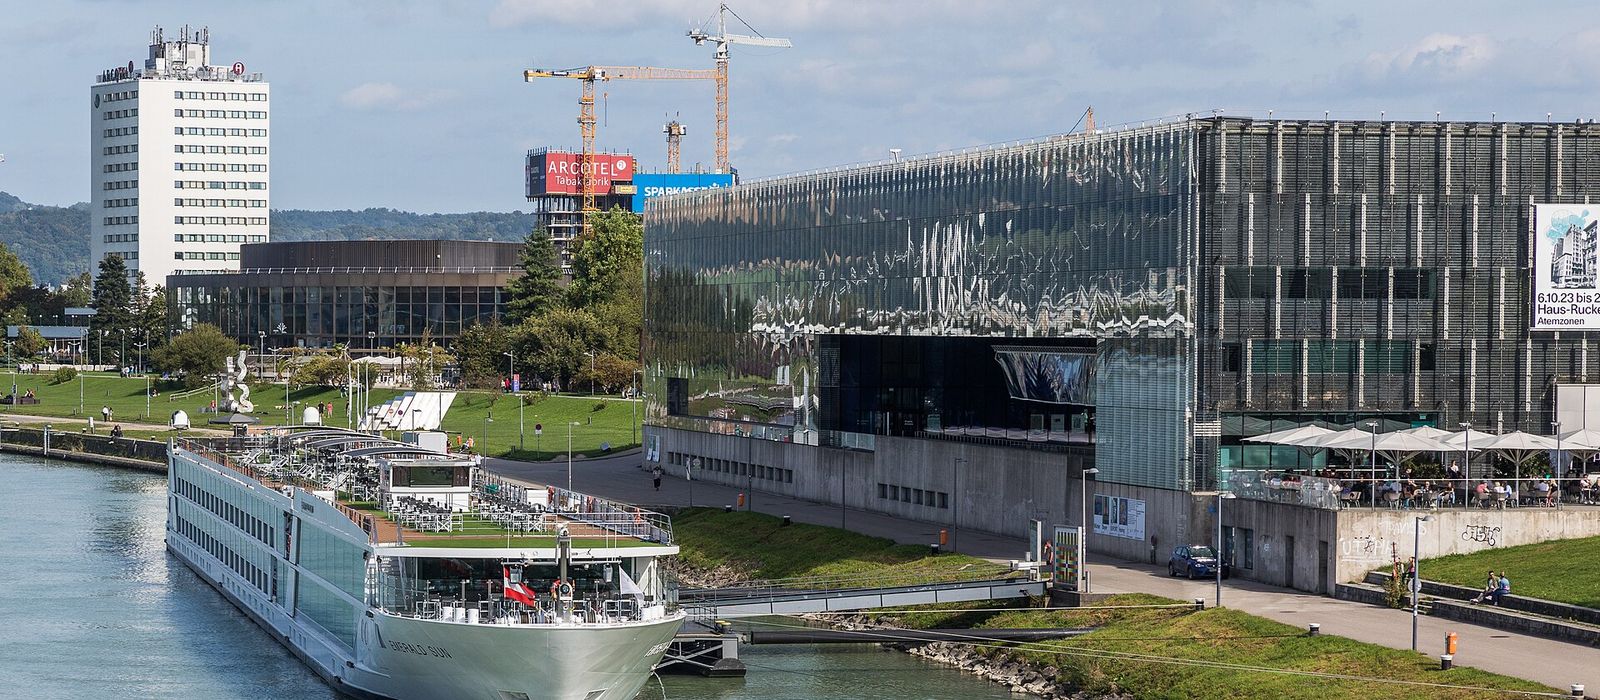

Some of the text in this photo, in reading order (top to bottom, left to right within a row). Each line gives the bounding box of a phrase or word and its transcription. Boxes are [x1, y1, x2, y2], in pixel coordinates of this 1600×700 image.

[548, 161, 618, 177] ARCOTEL
[555, 175, 609, 187] Tabakabrik
[644, 186, 708, 197] SPARKAS
[1537, 292, 1574, 303] 6.10.23
[1576, 292, 1592, 303] bis
[1537, 317, 1585, 325] Atemzonen
[388, 640, 453, 659] EMERALD SUN
